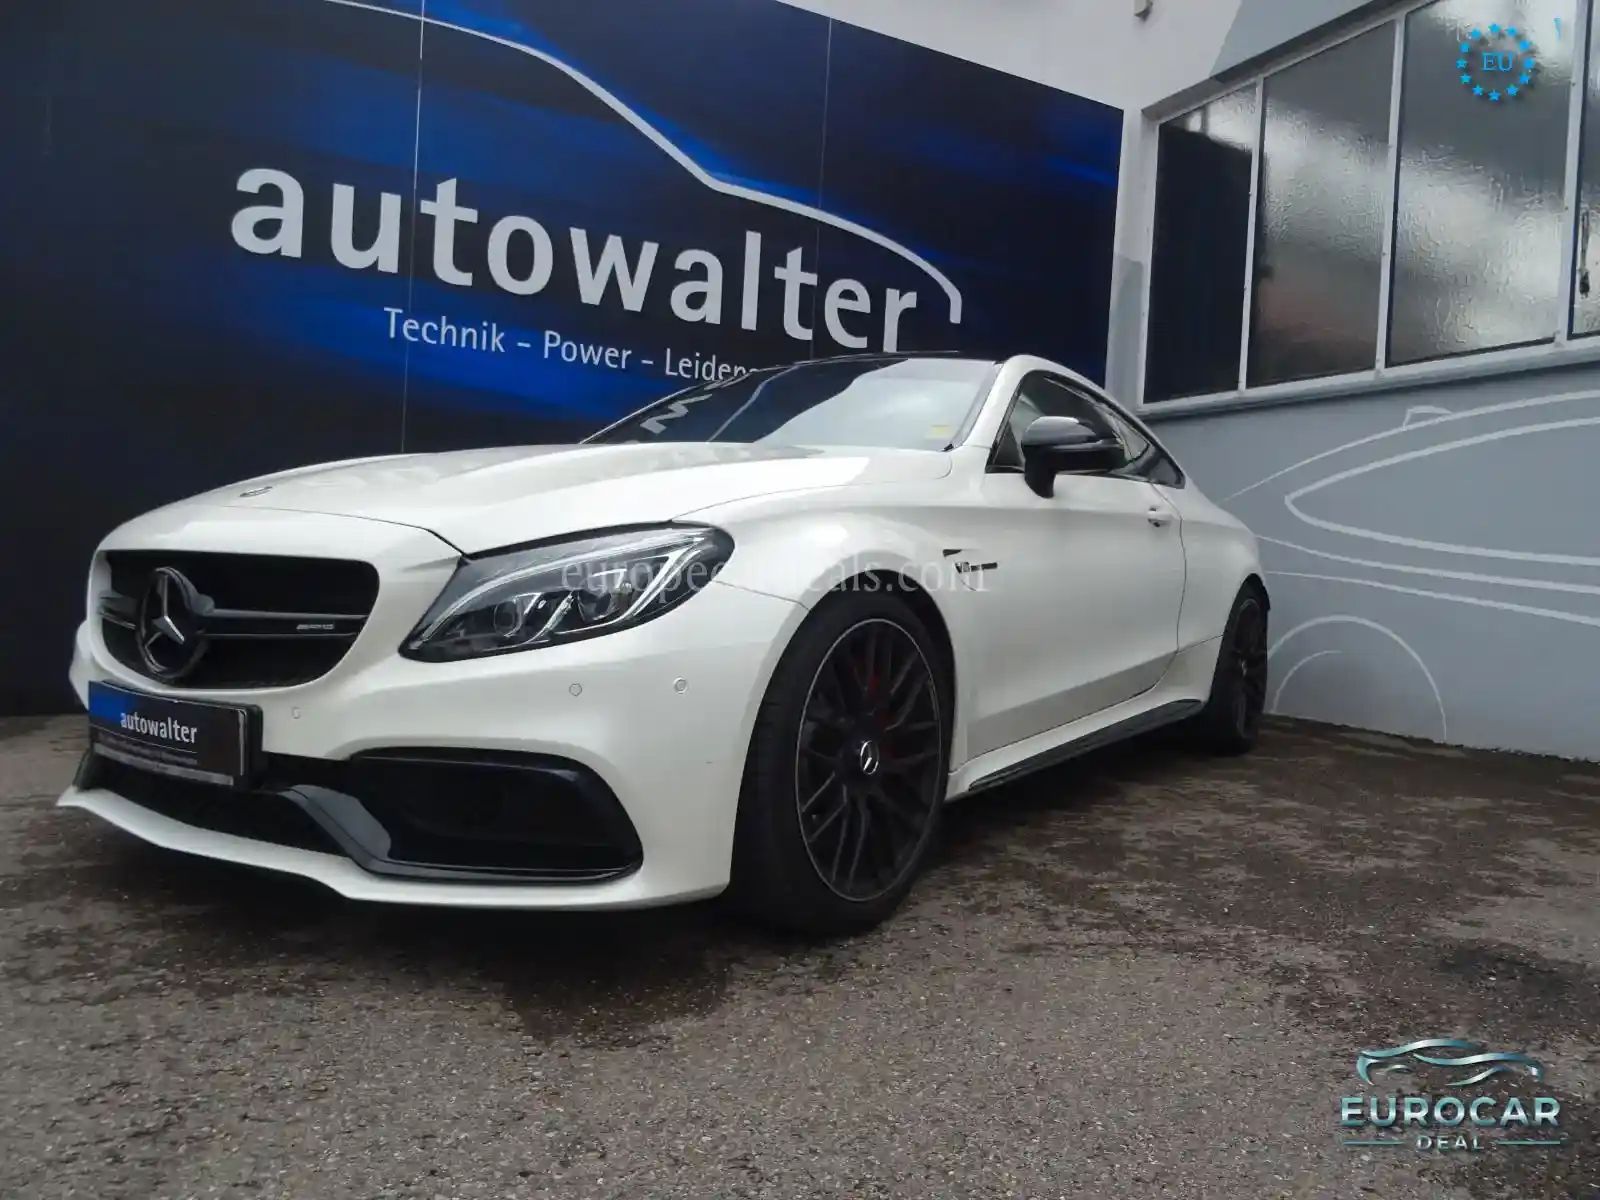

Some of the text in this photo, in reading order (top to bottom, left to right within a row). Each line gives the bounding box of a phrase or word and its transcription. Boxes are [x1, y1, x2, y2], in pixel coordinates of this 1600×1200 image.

[230, 167, 918, 353] autowalter
[383, 307, 505, 352] Technik
[543, 330, 632, 369] Power
[120, 711, 198, 744] autowalter
